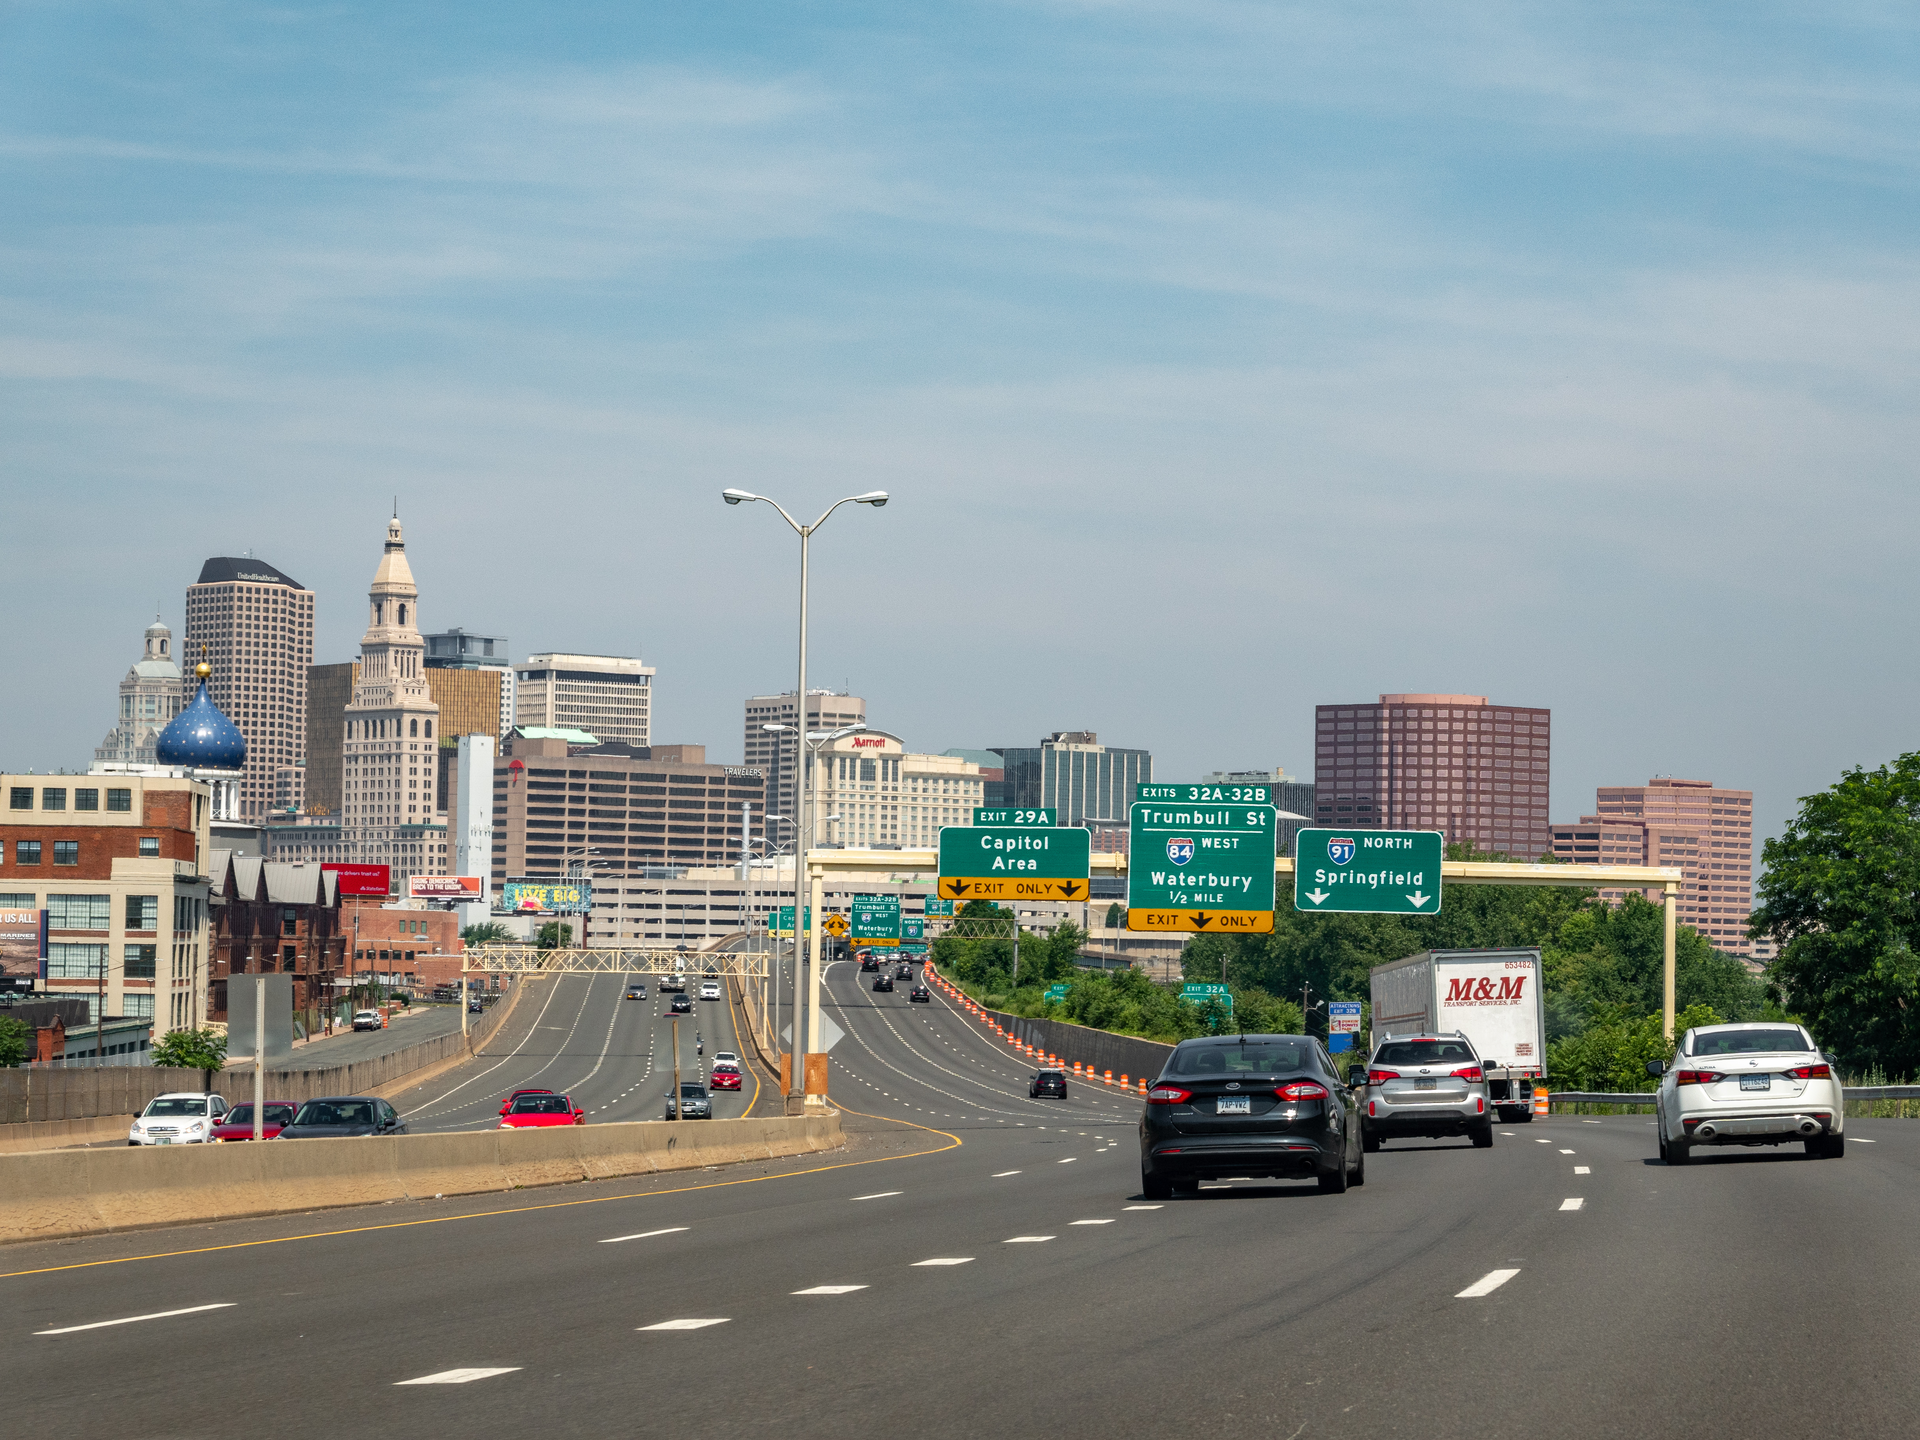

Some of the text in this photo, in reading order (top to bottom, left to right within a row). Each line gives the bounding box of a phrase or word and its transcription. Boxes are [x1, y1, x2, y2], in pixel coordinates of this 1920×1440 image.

[851, 736, 886, 749] Marriott
[724, 767, 762, 777] TRAVELERS
[1142, 787, 1266, 801] EXITS 32A-32B
[980, 810, 1049, 824] EXIT 29A
[1141, 809, 1266, 826] Trumbull St
[981, 835, 1049, 853] Capitol
[1201, 837, 1240, 849] WEST
[1363, 837, 1413, 849] NORTH
[1169, 845, 1192, 859] 84
[1331, 845, 1349, 859] 91
[991, 856, 1037, 871] Area
[1151, 871, 1253, 893] Waterbury
[1314, 868, 1423, 890] Springfield
[514, 888, 581, 902] LIVE BIG
[974, 882, 1053, 895] EXIT ONLY
[1169, 890, 1224, 904] 1/2 MILE
[5, 913, 17, 924] US
[18, 913, 37, 924] ALL.
[1147, 914, 1257, 927] EXIT ONLY
[857, 925, 894, 933] Waterbury
[1504, 961, 1532, 969] 653482
[1206, 985, 1225, 993] 32A
[1444, 975, 1528, 1002] M&M
[1443, 1000, 1478, 1008] TRANSPORT
[1478, 999, 1509, 1007] SERVICES,
